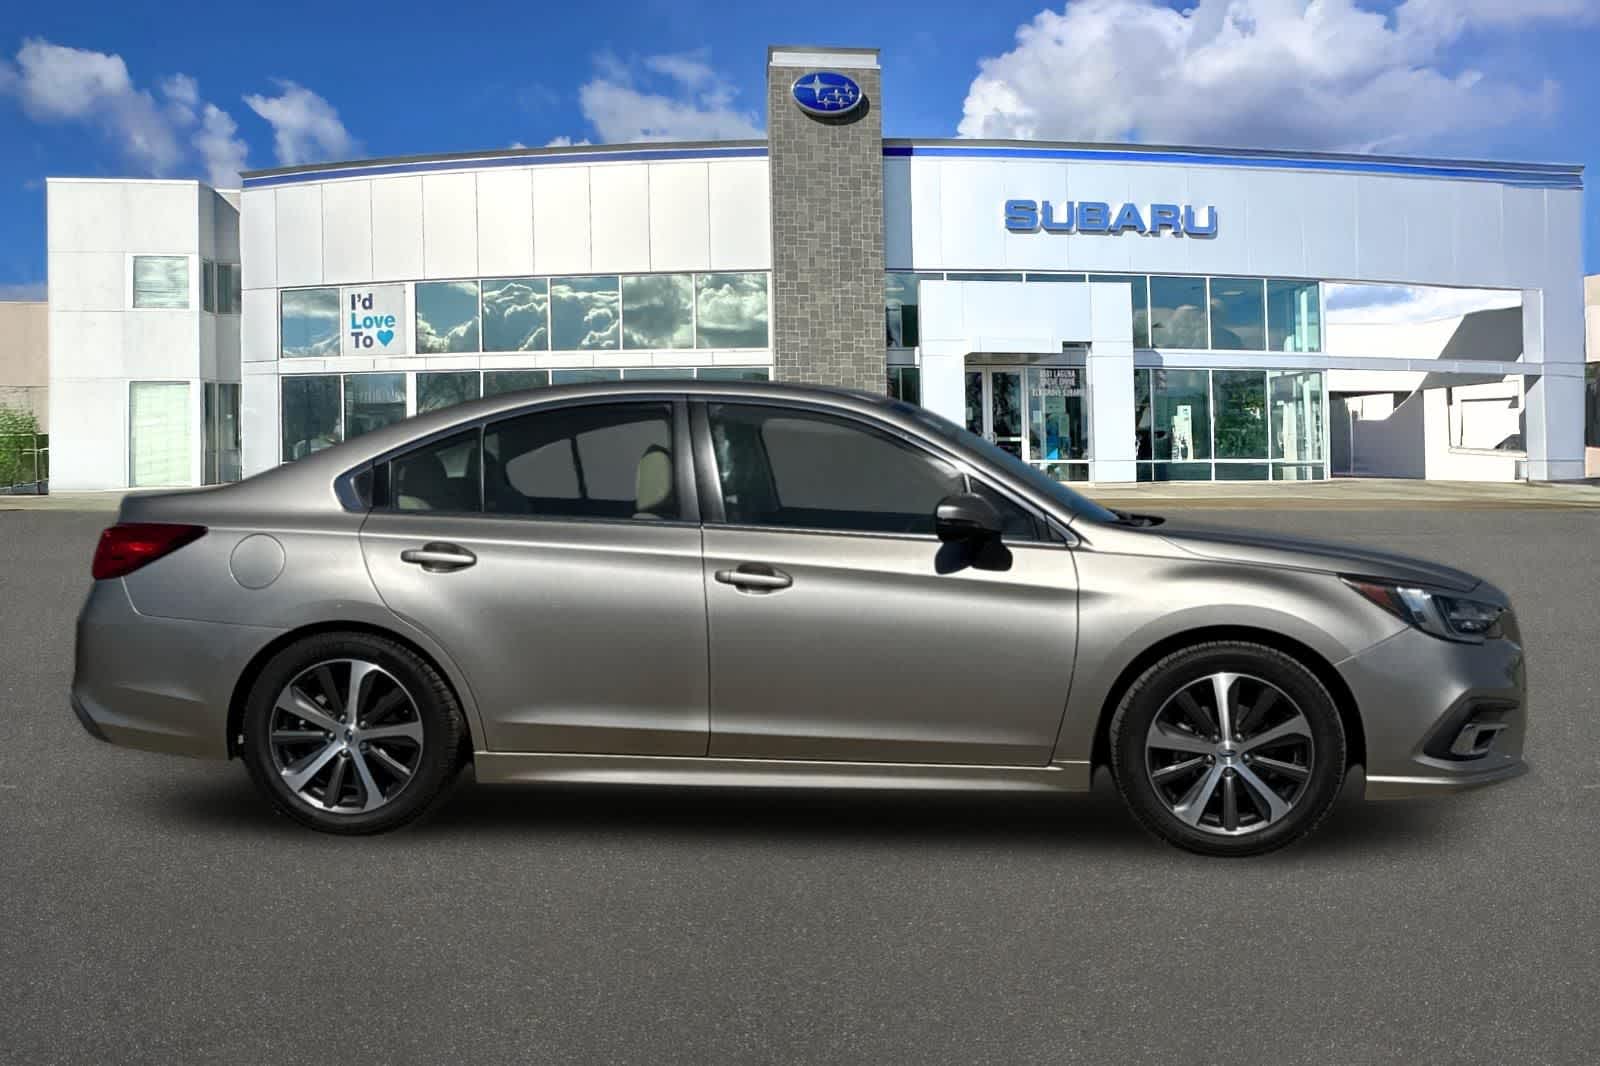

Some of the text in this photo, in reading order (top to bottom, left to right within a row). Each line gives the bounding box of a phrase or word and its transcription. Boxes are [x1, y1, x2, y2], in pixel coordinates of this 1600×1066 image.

[1005, 199, 1217, 237] SUBARU
[351, 293, 373, 310] I'd
[351, 312, 396, 329] Love
[351, 332, 374, 348] To
